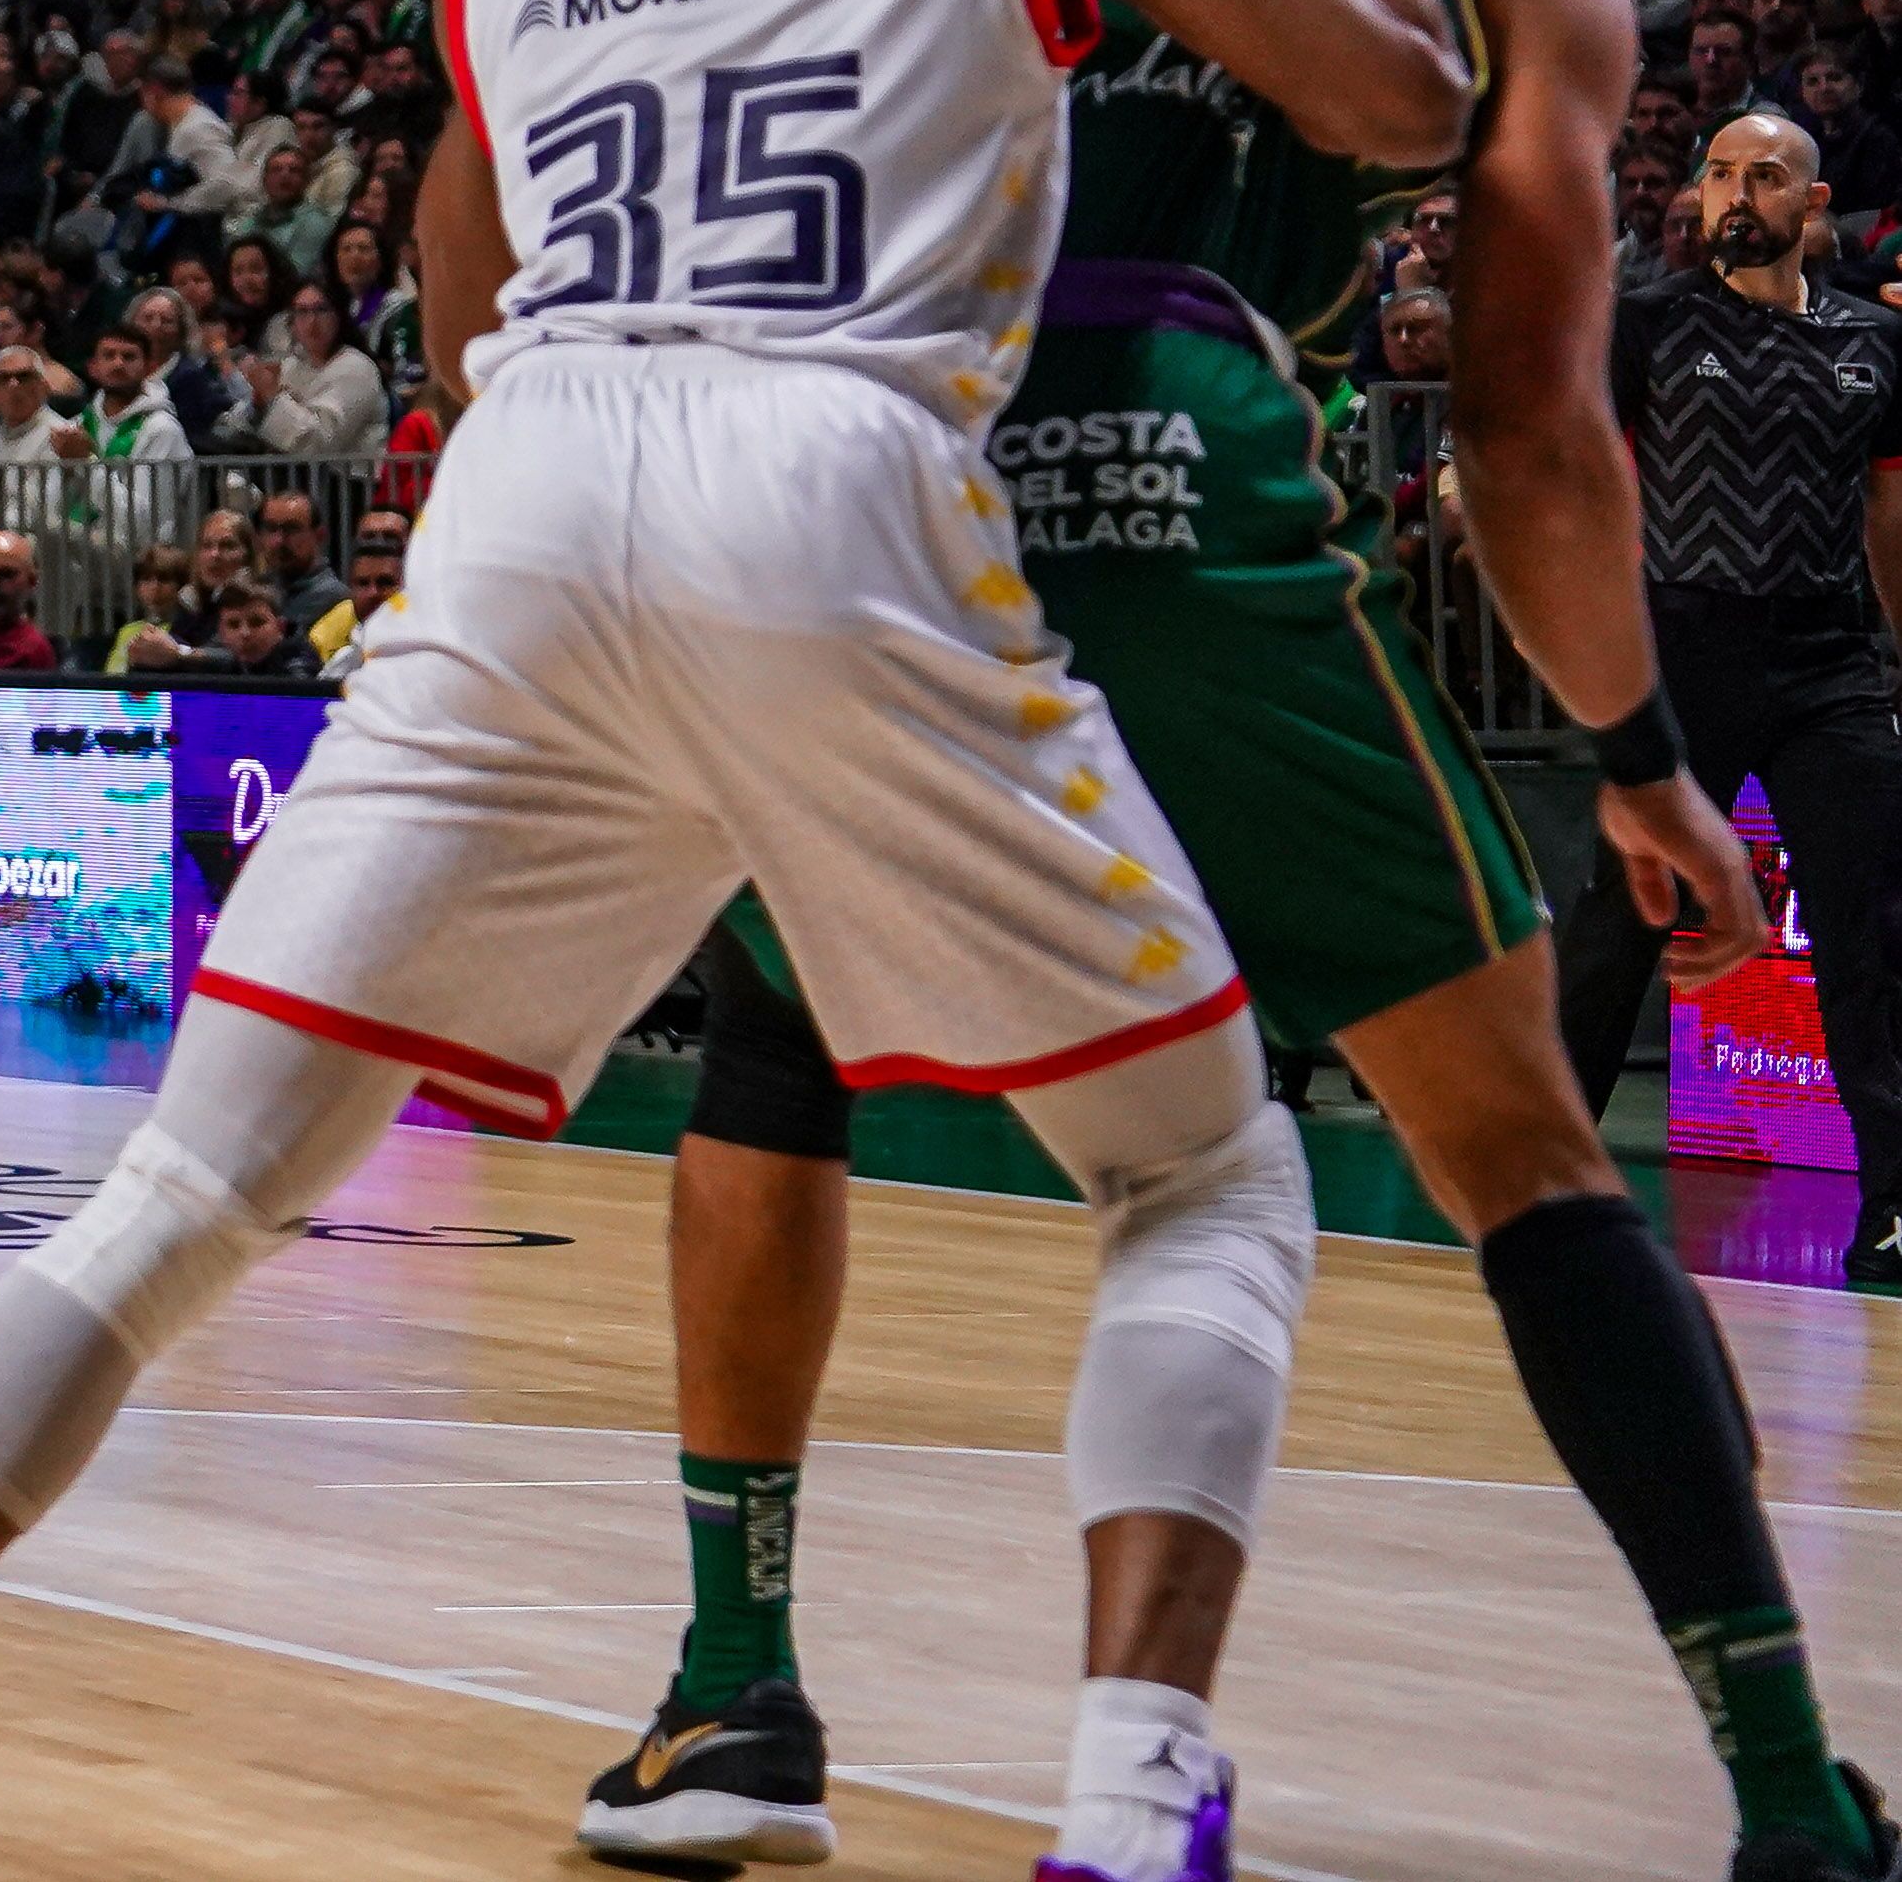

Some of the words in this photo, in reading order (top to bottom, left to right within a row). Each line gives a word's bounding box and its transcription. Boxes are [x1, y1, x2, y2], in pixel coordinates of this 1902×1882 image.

[509, 50, 868, 317] 35
[990, 410, 1207, 468] COSTA
[1013, 468, 1082, 509] EL
[1094, 463, 1205, 508] SOL
